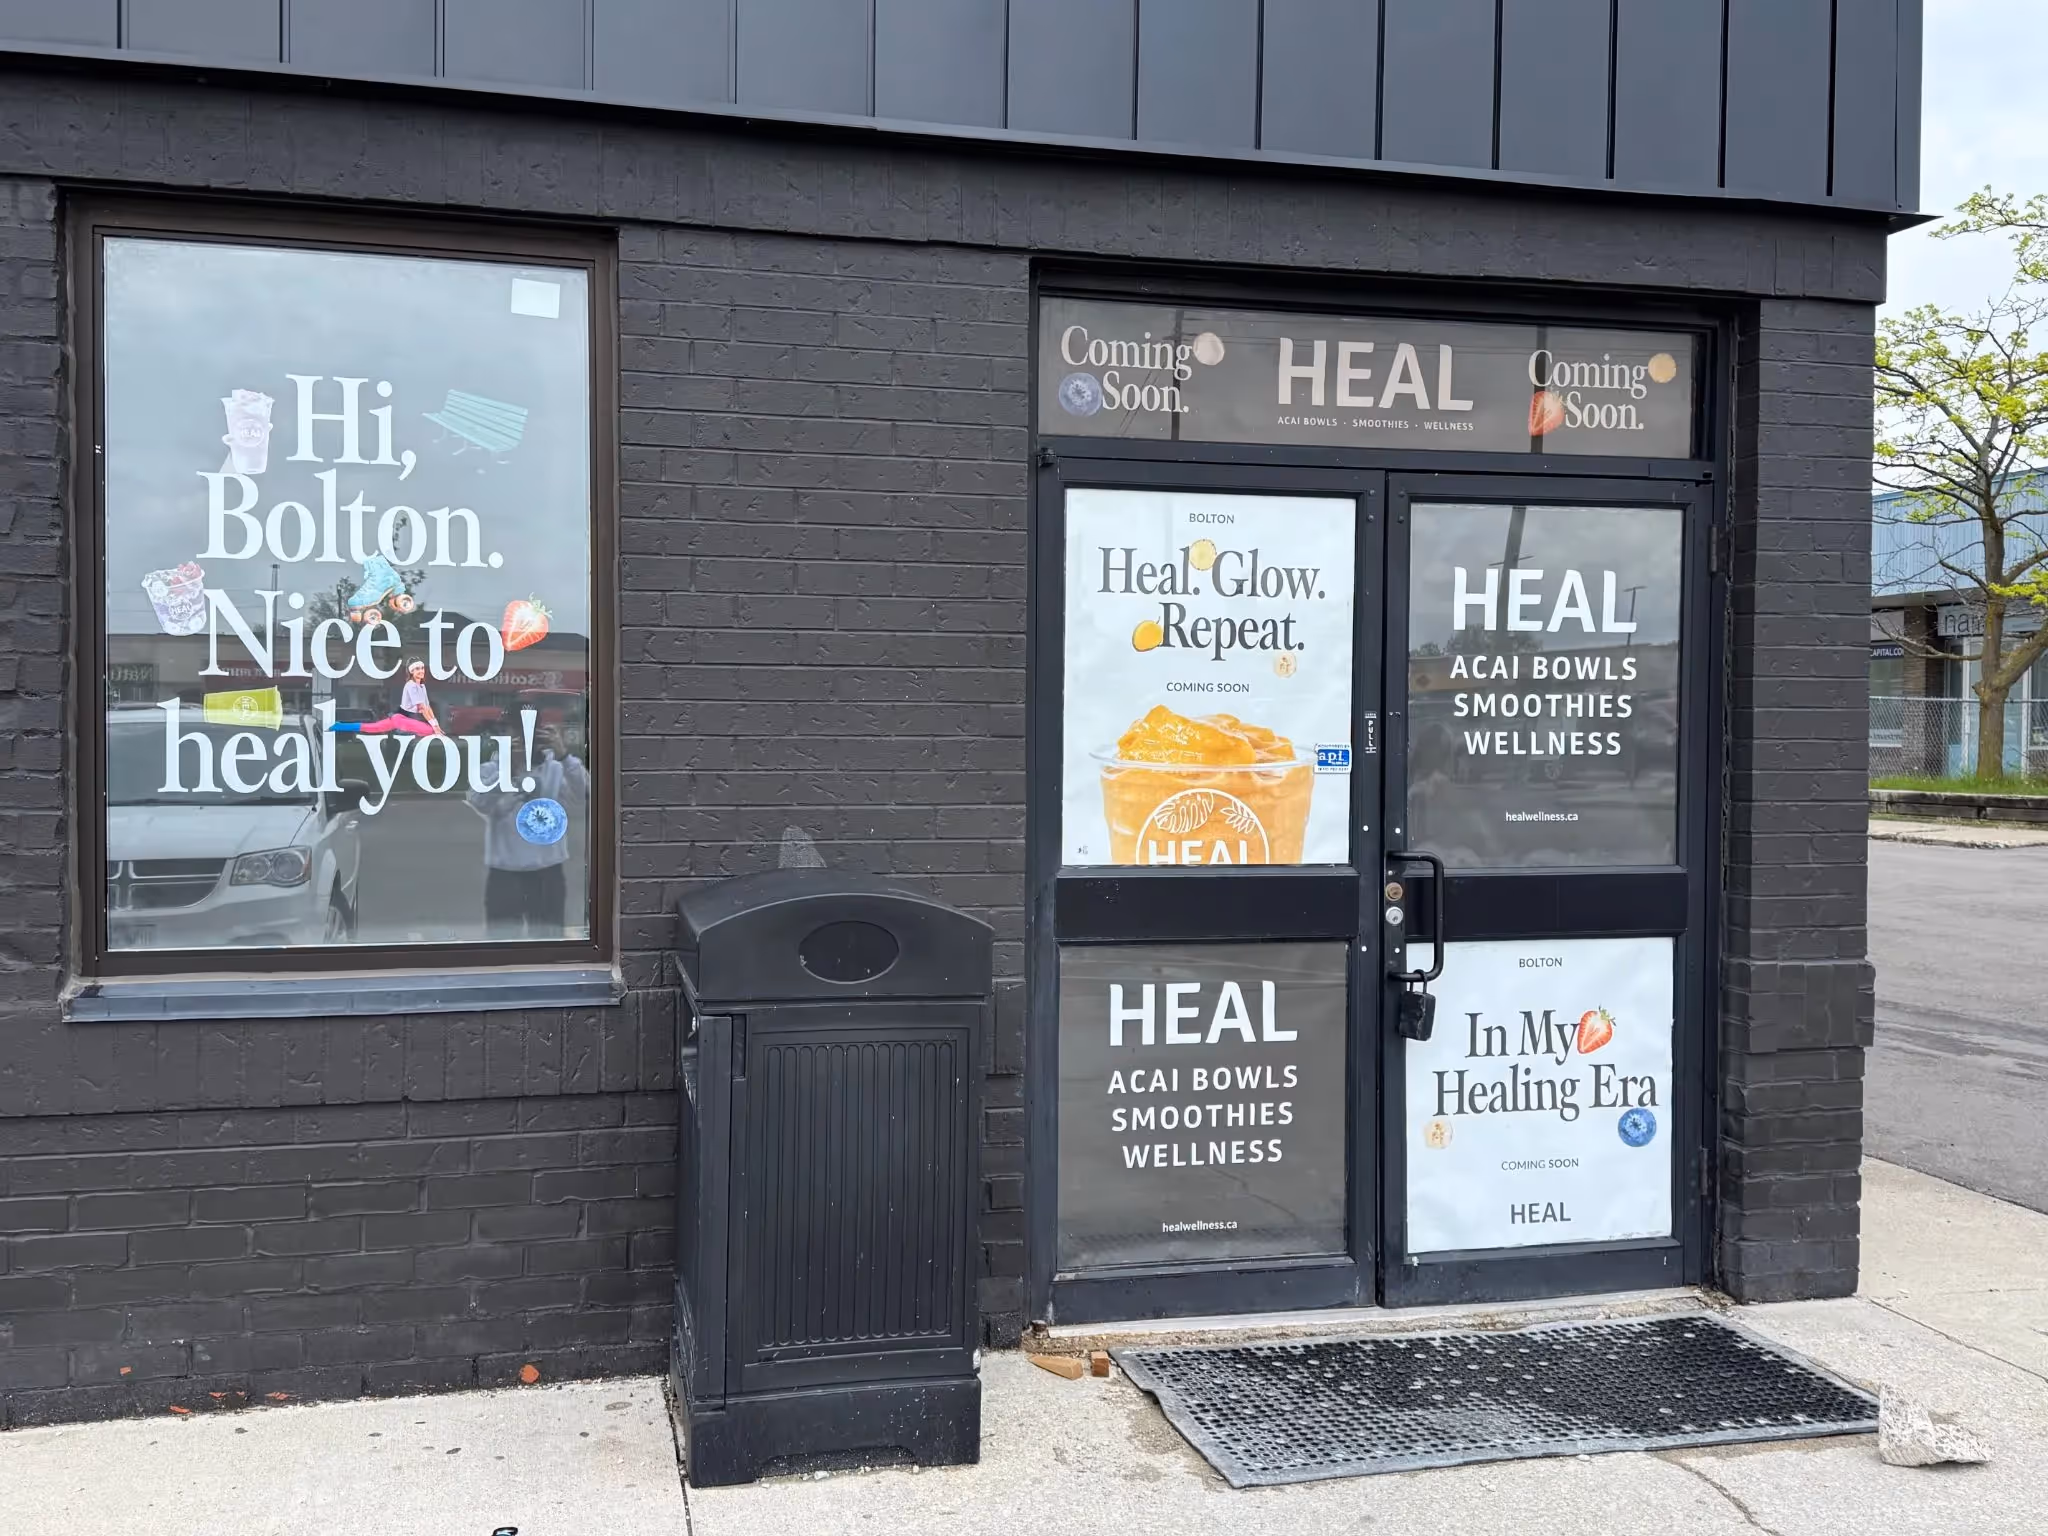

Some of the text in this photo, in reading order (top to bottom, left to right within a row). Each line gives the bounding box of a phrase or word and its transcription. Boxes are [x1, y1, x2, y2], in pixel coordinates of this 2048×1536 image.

[1061, 325, 1193, 381] Coming
[1101, 370, 1190, 413] Soon.
[1277, 336, 1475, 412] HEAL
[1528, 349, 1649, 400] Coming
[285, 373, 418, 481] Hi,
[1277, 415, 1475, 432] ACAI BOWLS SMOOTHIES WELLNESS
[1564, 391, 1645, 430] Soon.
[196, 468, 505, 569] Bolton.
[1188, 512, 1236, 525] BOLTON
[1097, 545, 1326, 600] Heal. Glow.
[1453, 566, 1637, 633] HEAL
[198, 588, 506, 682] Nice to
[1157, 601, 1305, 662] Repeat.
[1166, 681, 1250, 693] COMING SOON
[1449, 655, 1637, 681] ACAI BOWLS
[1453, 693, 1633, 718] SMOOTHIES
[156, 696, 538, 816] heal you!
[1463, 731, 1622, 756] WELLNESS
[1504, 811, 1580, 823] healwellness.ca
[1518, 957, 1564, 969] BOLTON
[1109, 980, 1299, 1047] HEAL
[1464, 1009, 1581, 1066] In My
[1107, 1065, 1299, 1094] ACAI BOWLS
[1432, 1063, 1660, 1122] Healing Era
[1111, 1101, 1294, 1132] SMOOTHIES
[1122, 1138, 1284, 1169] WELLNESS
[1501, 1157, 1579, 1171] COMING SOON
[1161, 1219, 1239, 1234] healwellness.ca
[1510, 1201, 1572, 1225] HEAL
